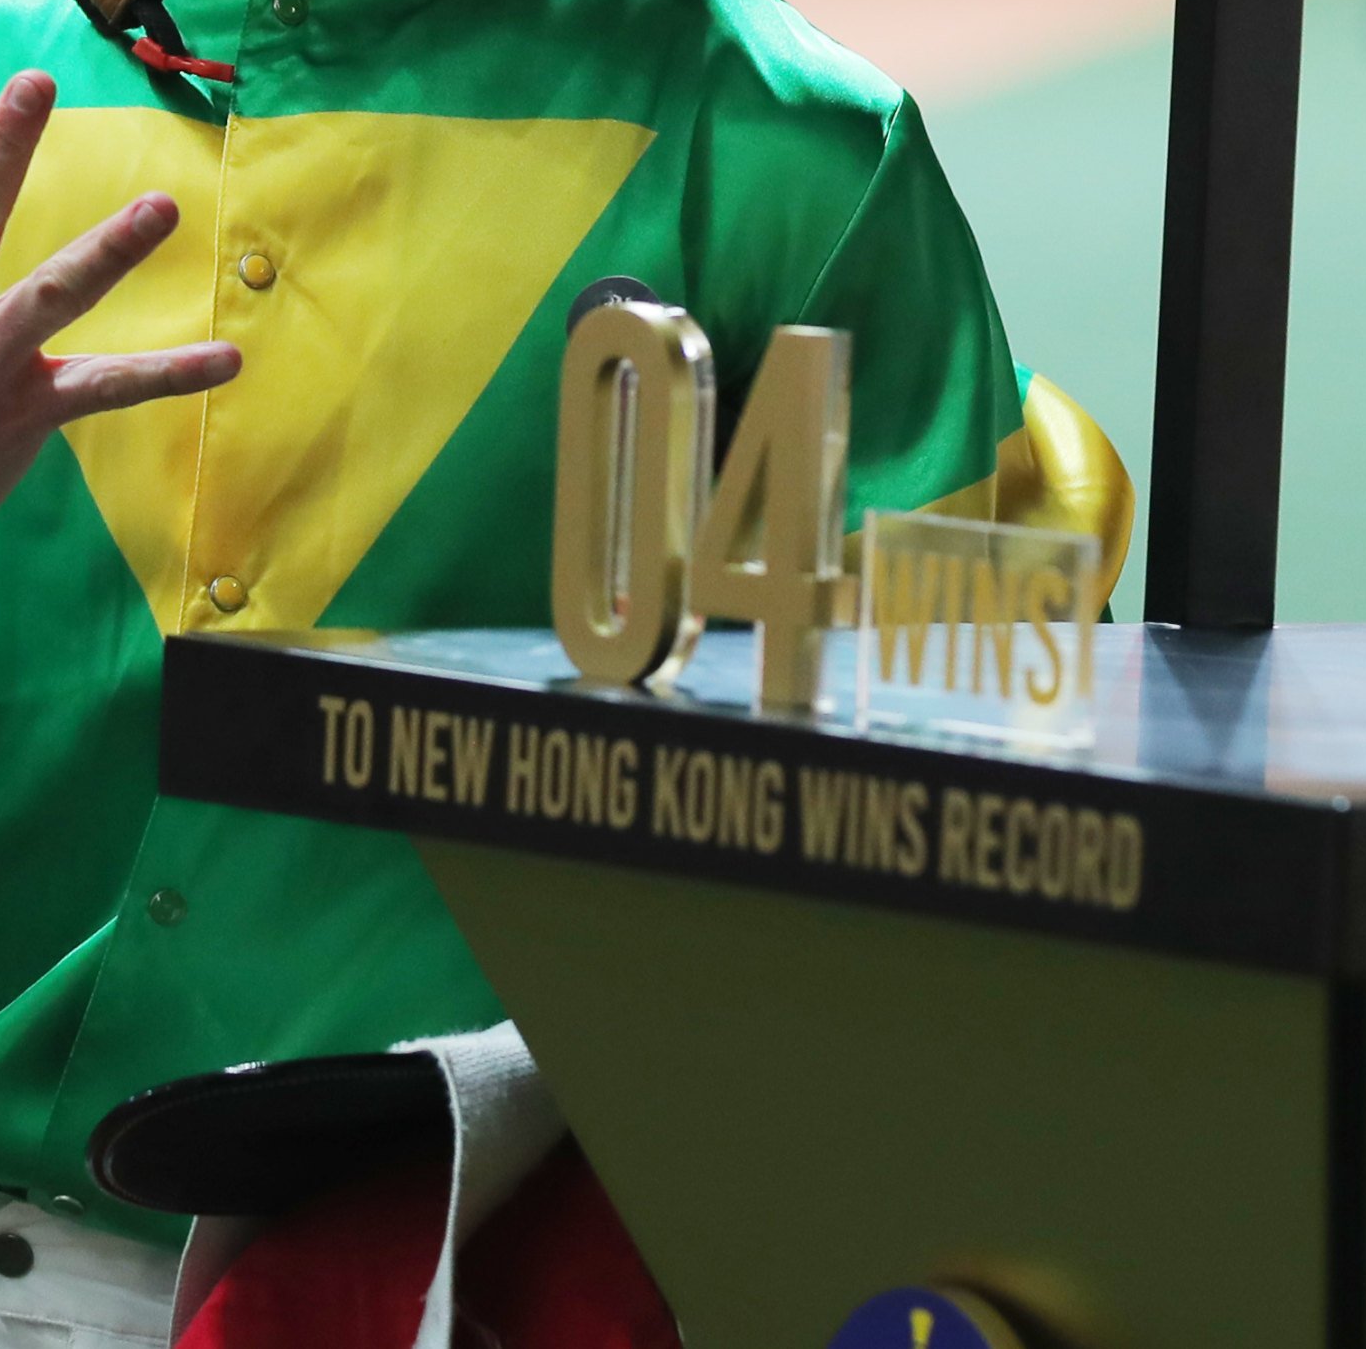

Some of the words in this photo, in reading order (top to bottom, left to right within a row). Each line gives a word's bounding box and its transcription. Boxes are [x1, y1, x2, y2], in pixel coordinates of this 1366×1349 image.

[551, 301, 859, 717] 04
[318, 695, 373, 789] TO
[388, 707, 493, 807] NEW
[506, 725, 635, 829] HONG
[651, 746, 782, 851] KONG
[799, 767, 929, 876] WINS
[938, 789, 1143, 911] RECORD
